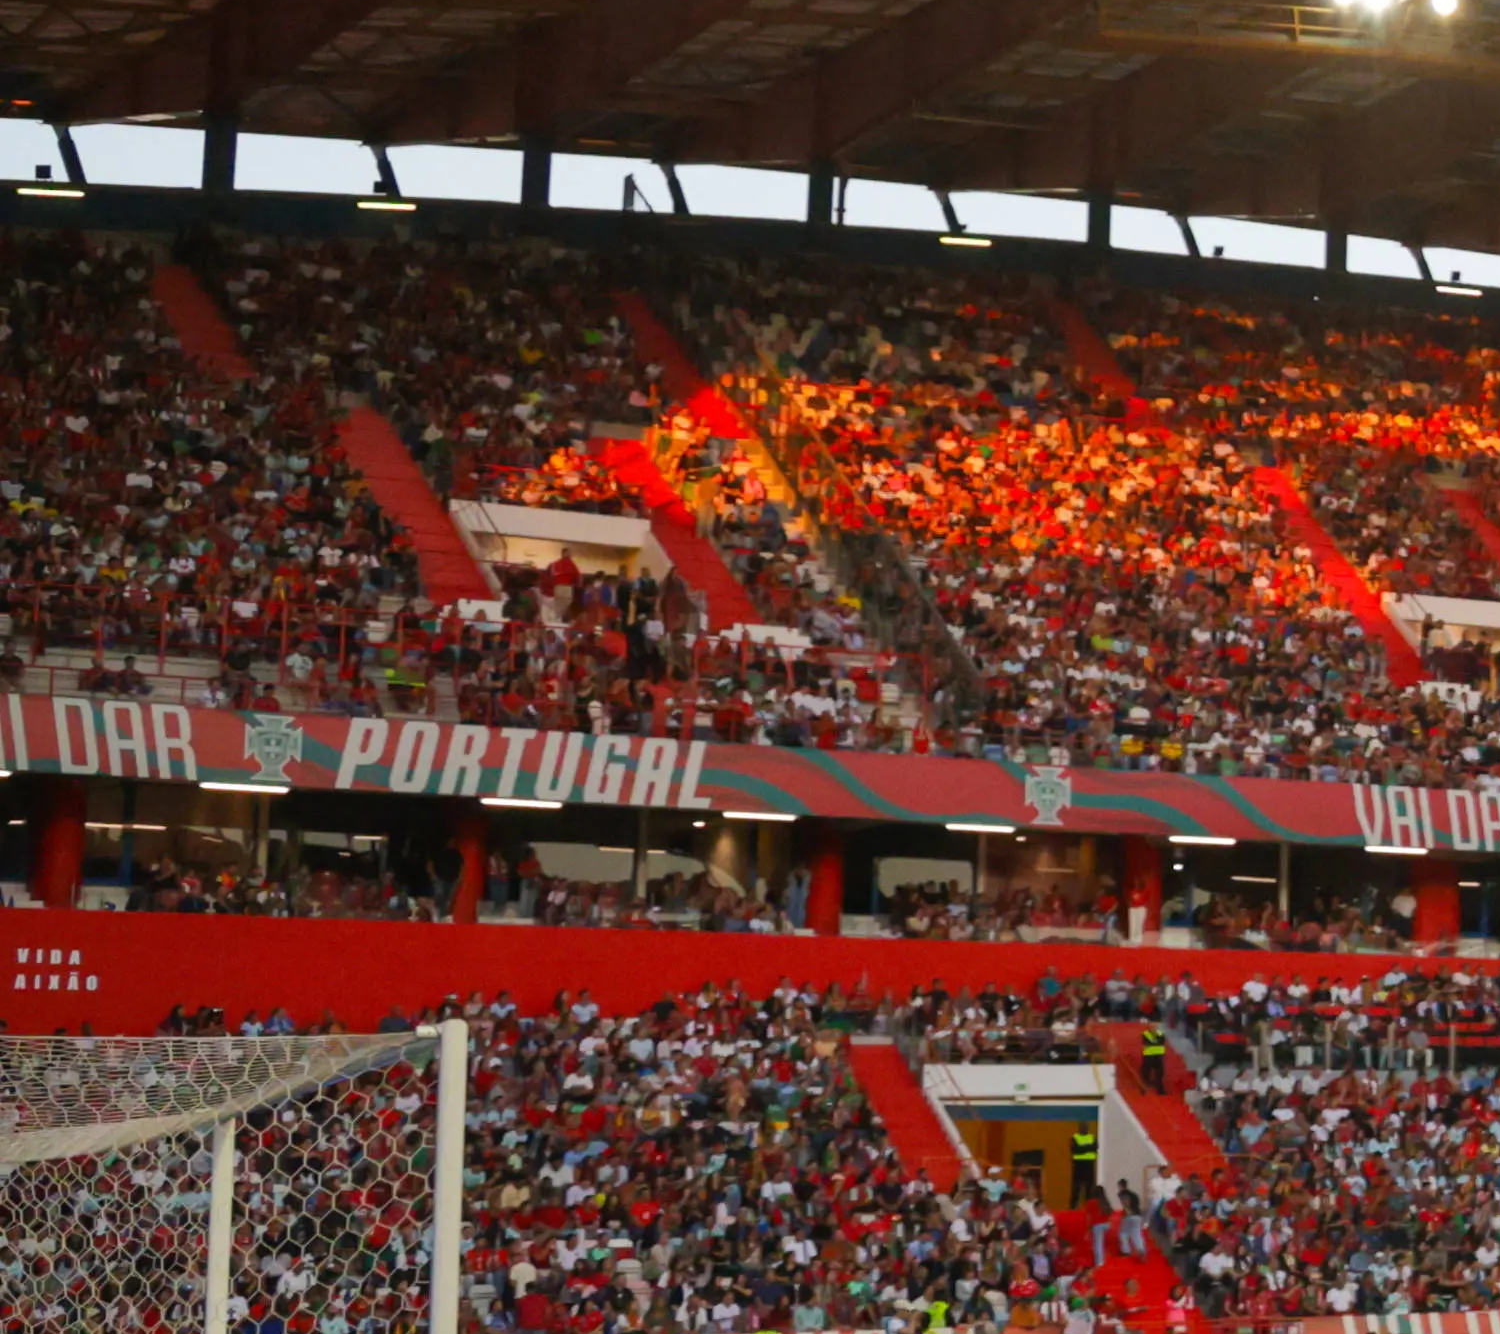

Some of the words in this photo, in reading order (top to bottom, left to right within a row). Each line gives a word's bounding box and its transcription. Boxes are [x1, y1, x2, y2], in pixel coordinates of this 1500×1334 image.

[53, 697, 198, 781] DAR
[335, 717, 712, 809] PORTUGAL
[1353, 784, 1434, 849] VAI
[17, 948, 81, 965] VIDA
